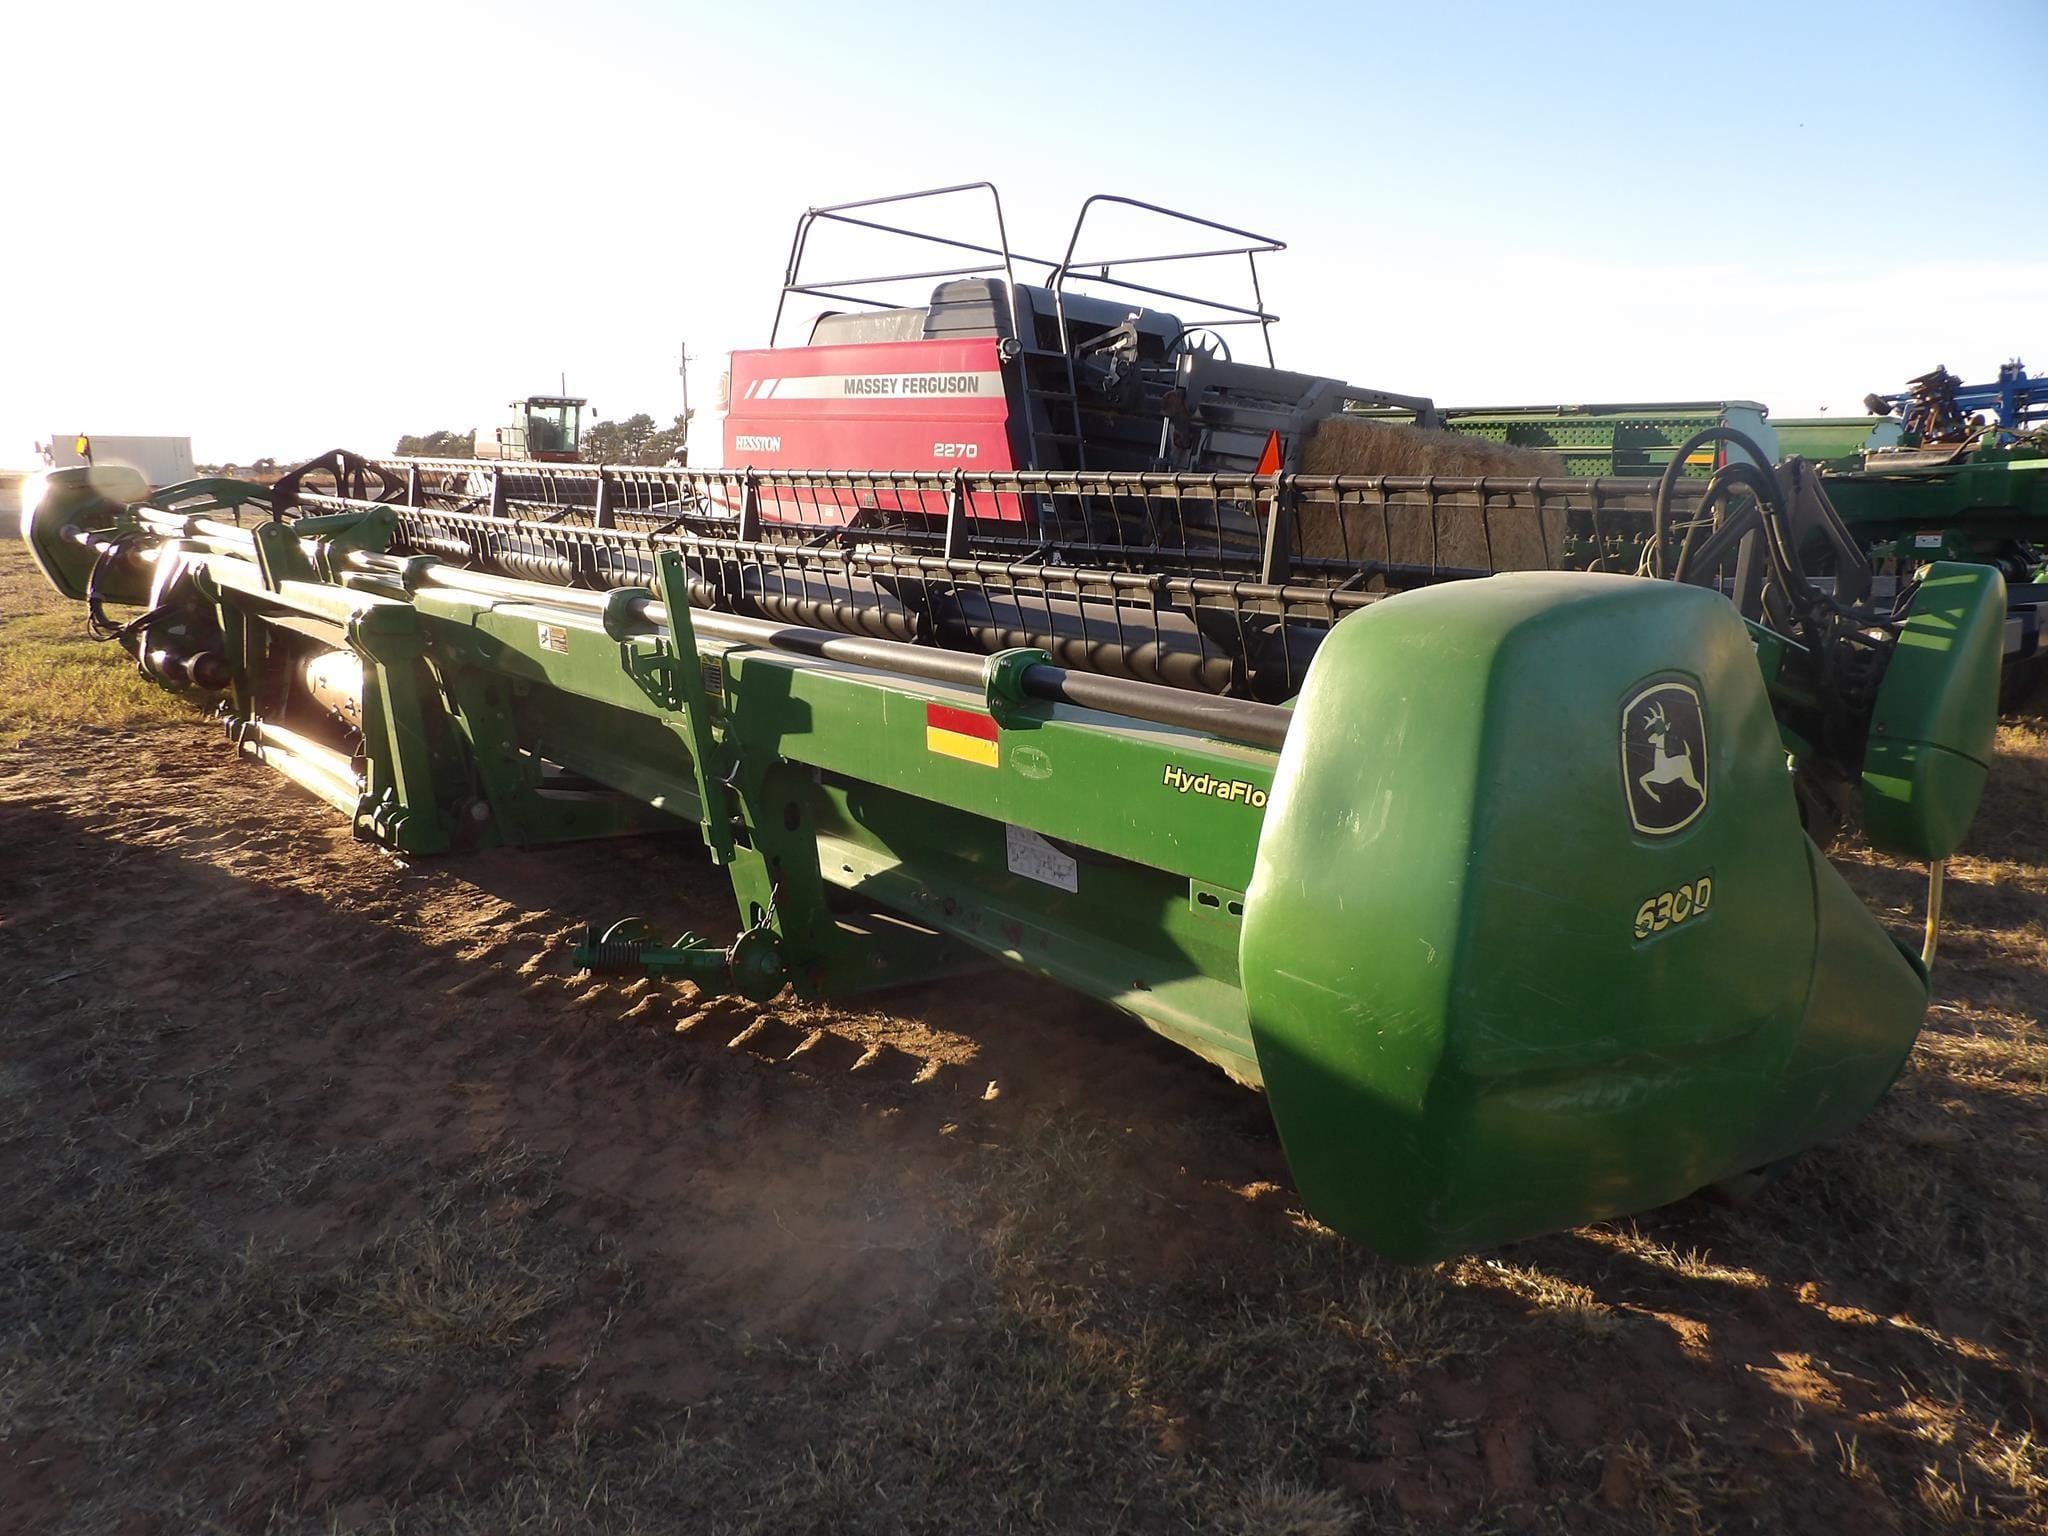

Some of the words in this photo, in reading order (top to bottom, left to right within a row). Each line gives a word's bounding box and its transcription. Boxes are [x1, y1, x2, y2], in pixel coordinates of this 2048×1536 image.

[843, 377, 898, 395] MASSEY
[902, 375, 980, 394] FERGUSON
[735, 435, 781, 452] HESSTON
[933, 443, 977, 458] 2270
[1163, 764, 1269, 808] HydraFlo
